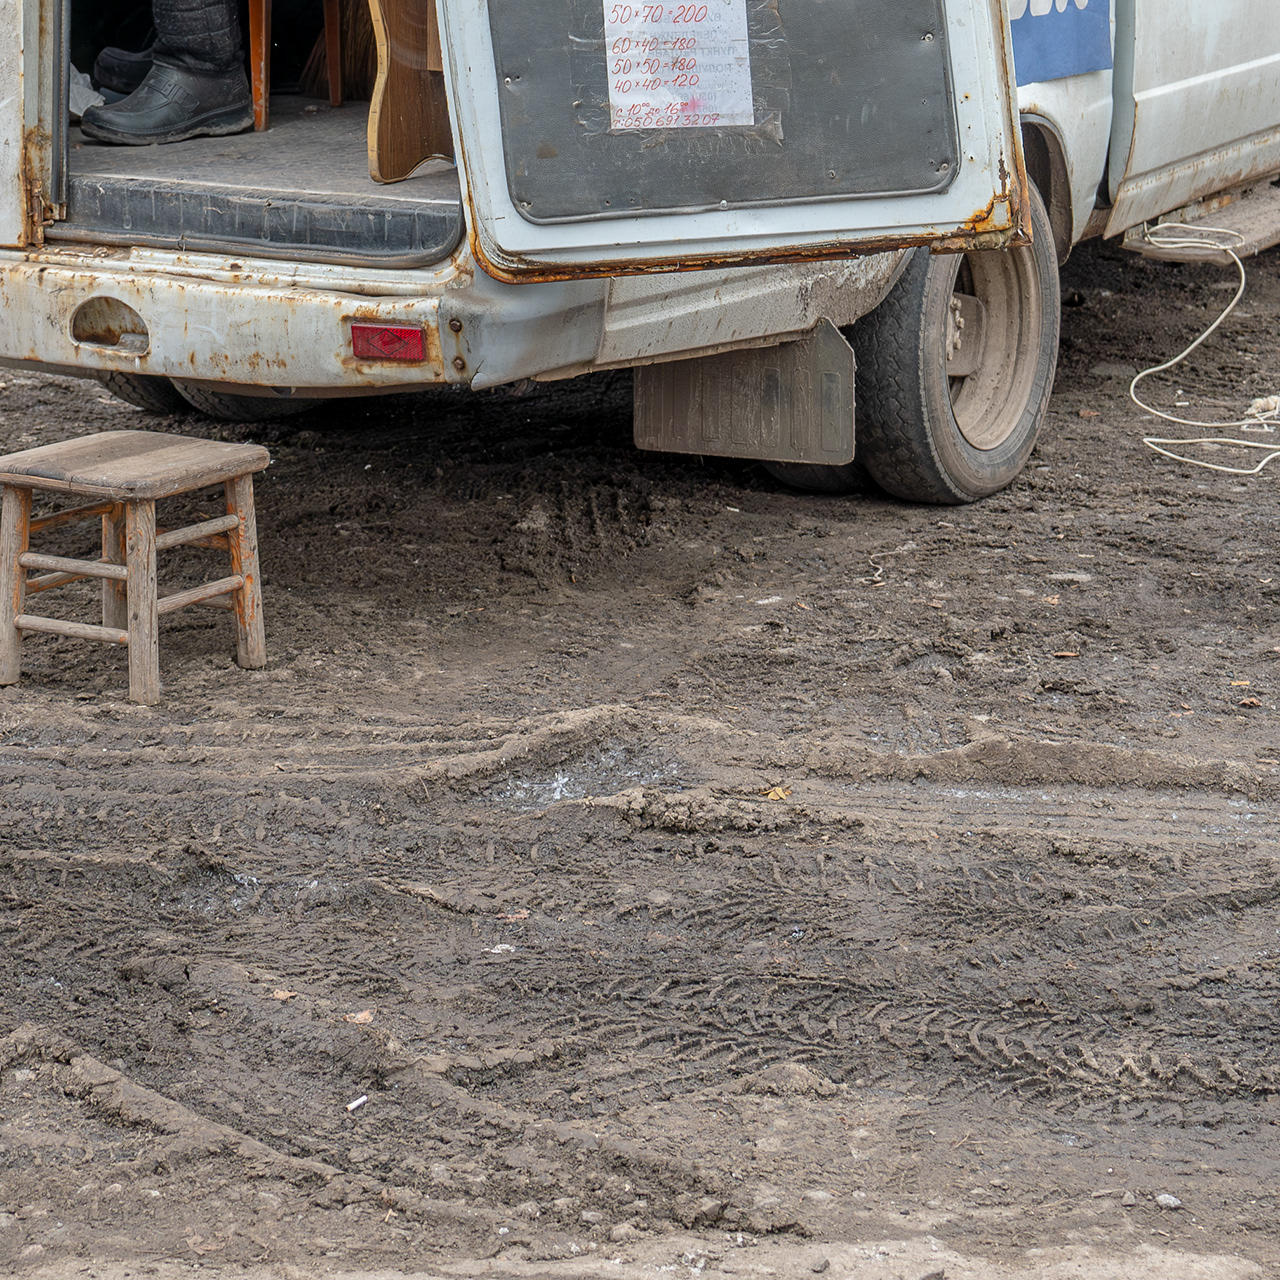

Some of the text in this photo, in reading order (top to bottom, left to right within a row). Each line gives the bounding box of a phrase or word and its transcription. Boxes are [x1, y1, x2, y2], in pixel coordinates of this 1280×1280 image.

[673, 4, 708, 24] 200
[672, 37, 696, 50] 180
[671, 57, 697, 71] 180
[672, 74, 699, 87] 120
